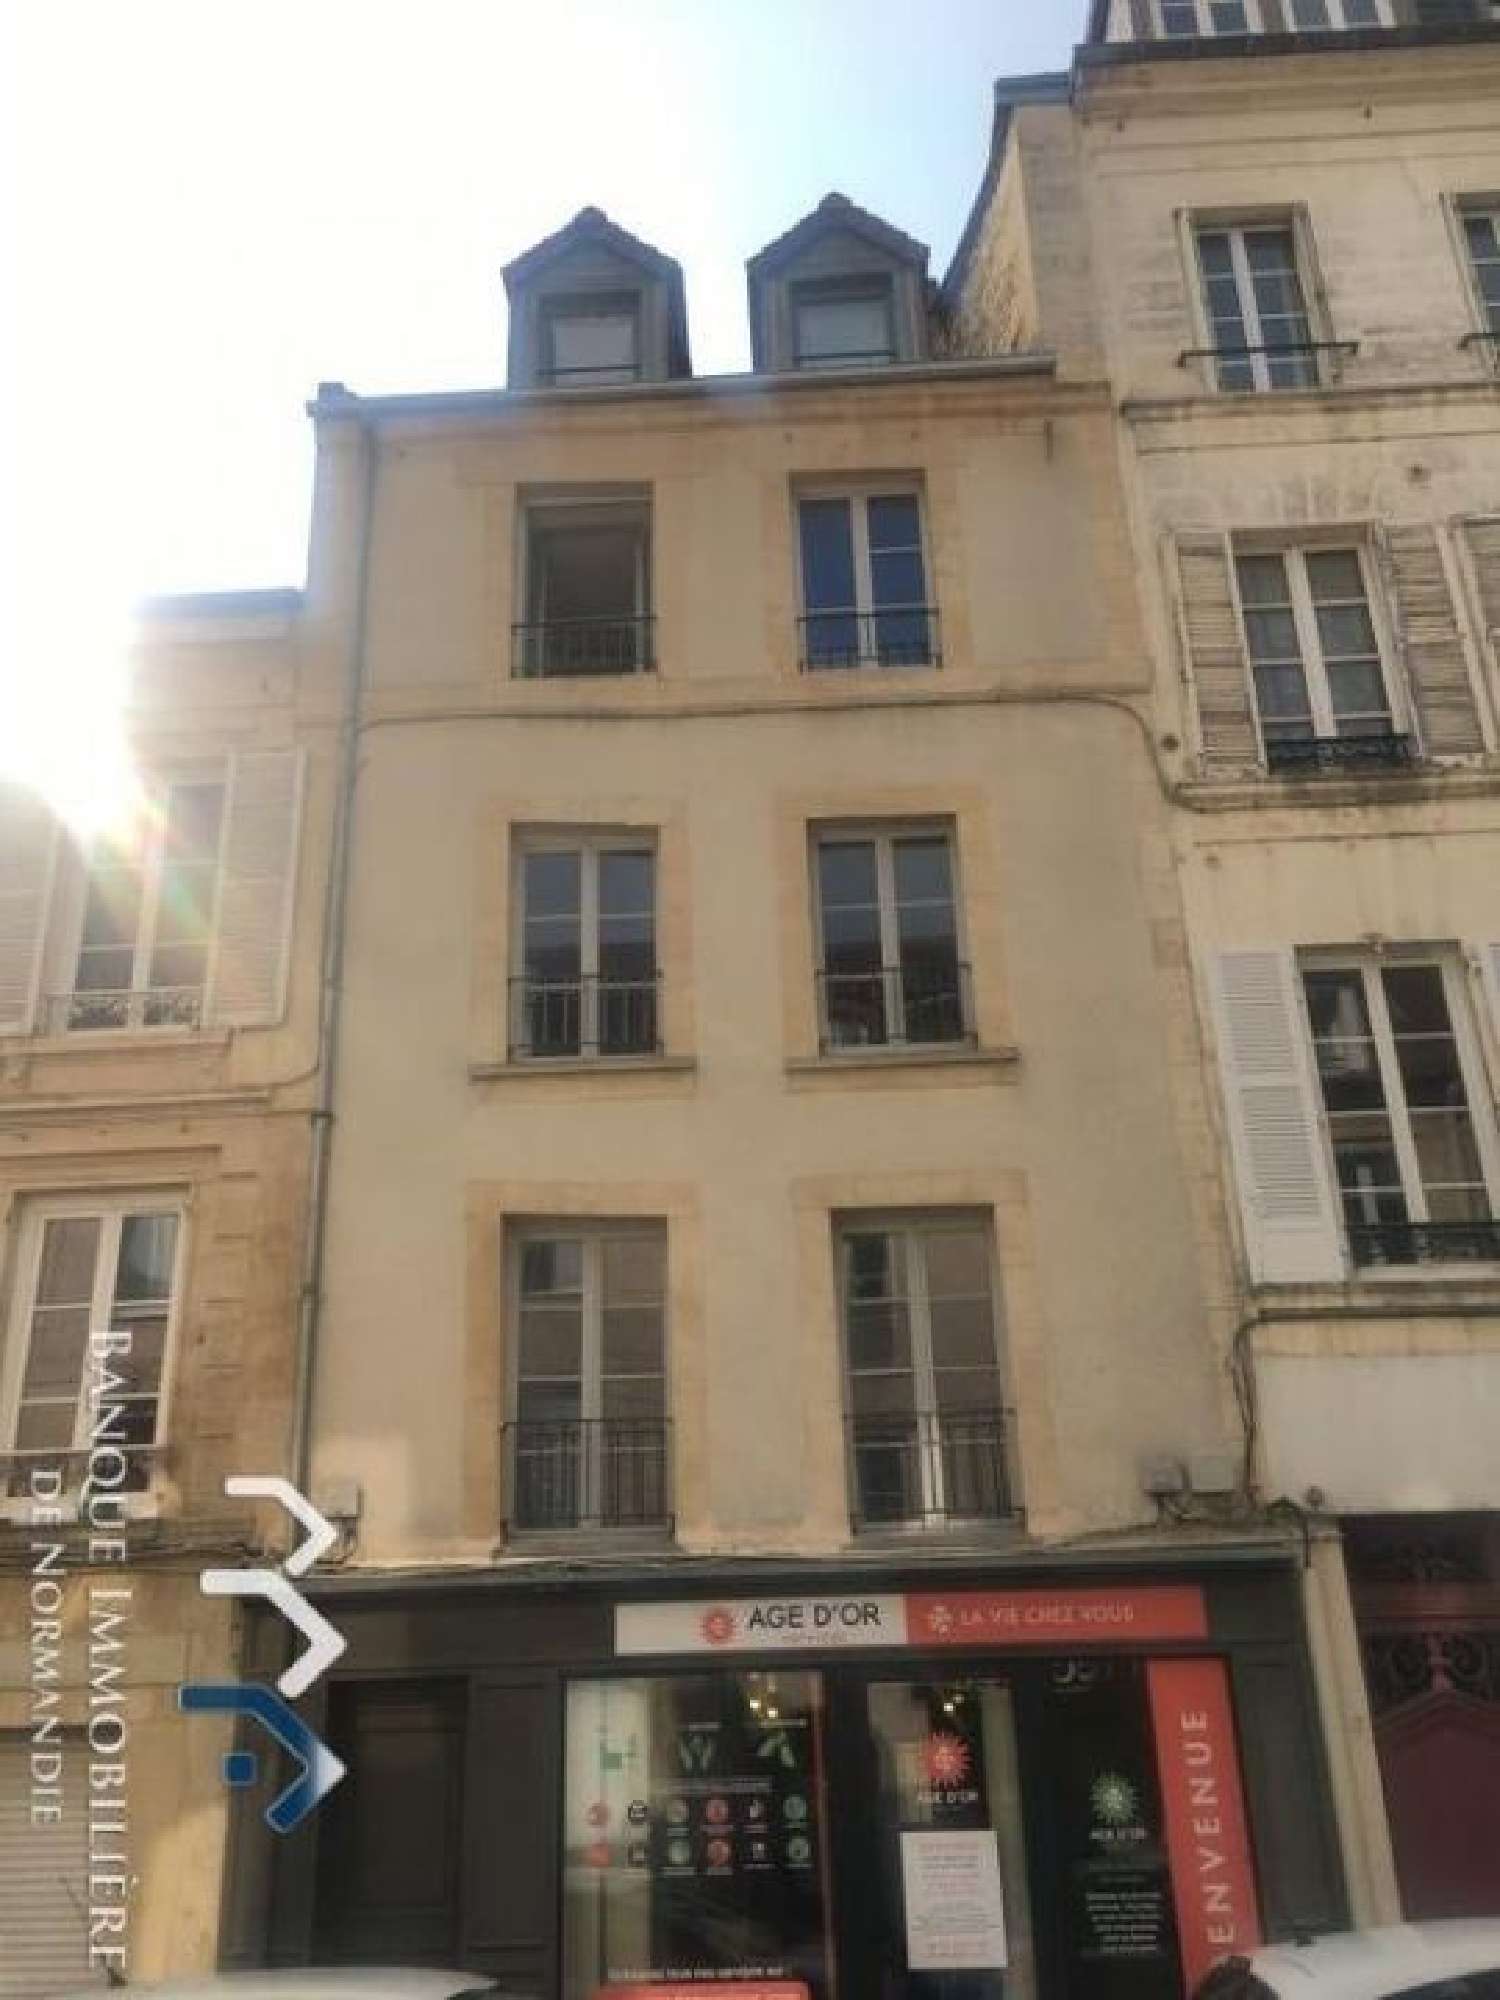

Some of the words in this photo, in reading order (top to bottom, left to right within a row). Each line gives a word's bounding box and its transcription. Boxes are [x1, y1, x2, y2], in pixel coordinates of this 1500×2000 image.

[748, 1604, 803, 1629] AGE
[814, 1602, 881, 1626] D'OR
[1180, 1709, 1235, 1966] ENVENUE
